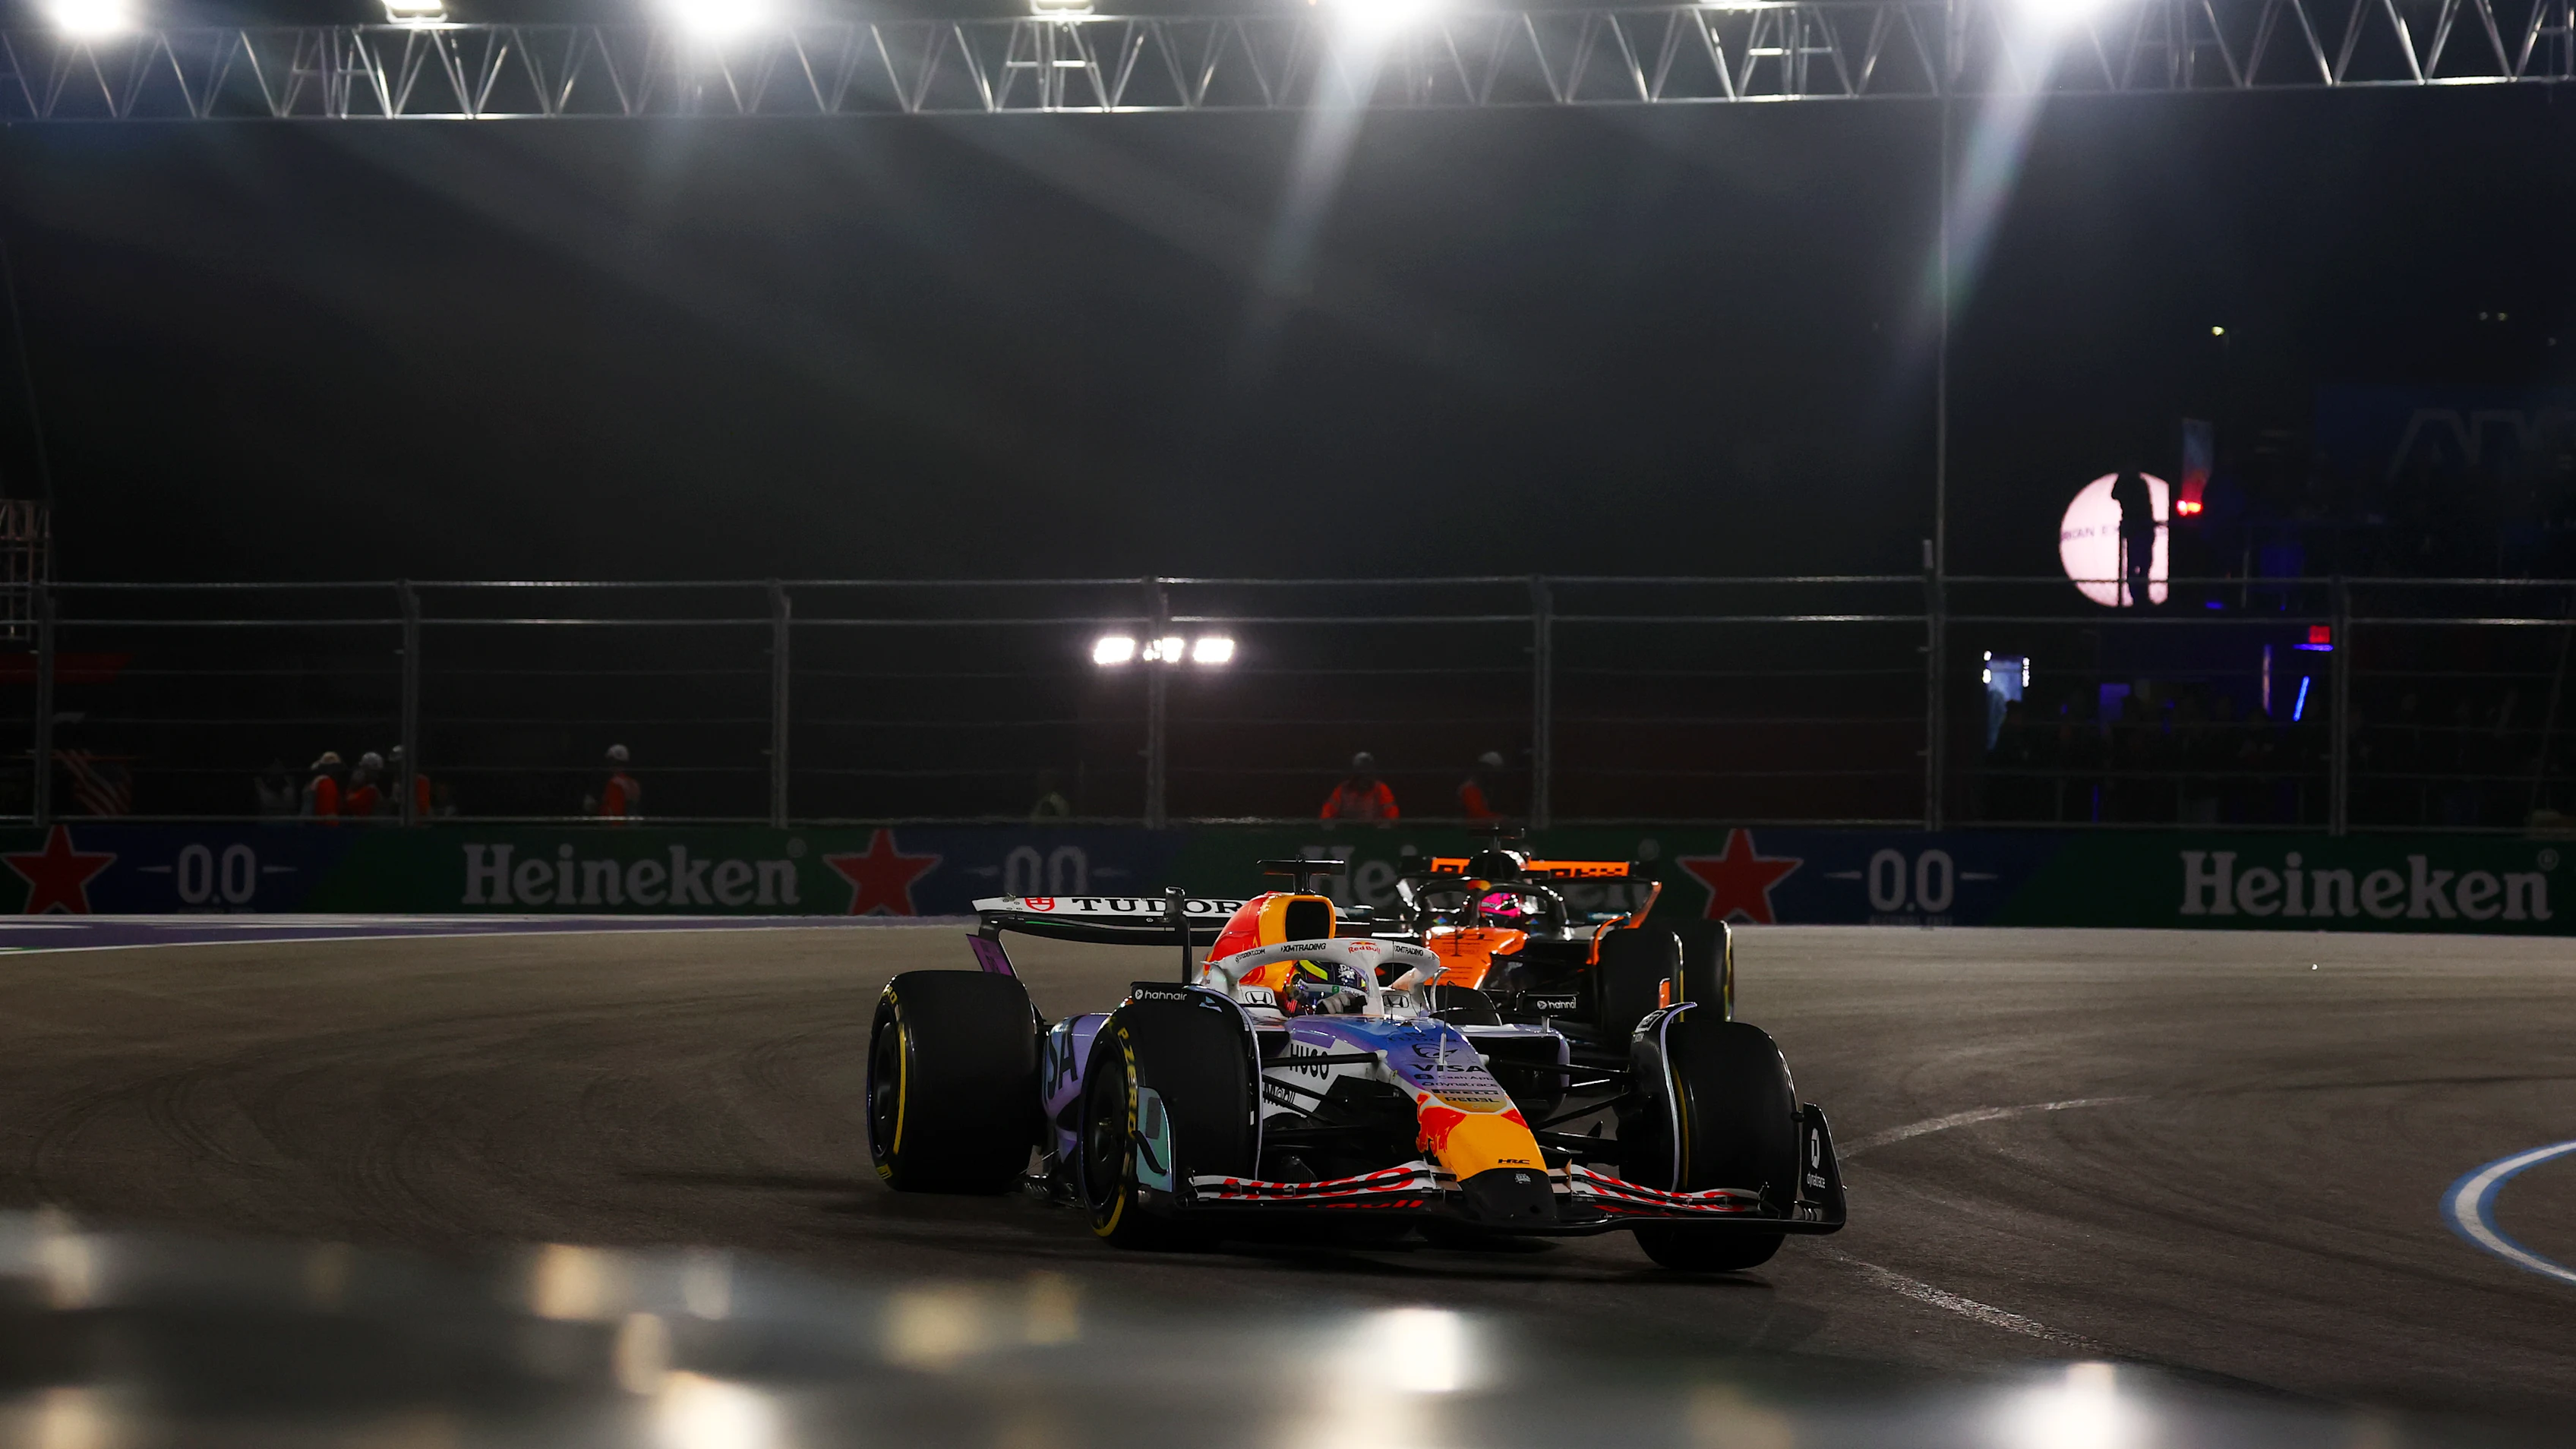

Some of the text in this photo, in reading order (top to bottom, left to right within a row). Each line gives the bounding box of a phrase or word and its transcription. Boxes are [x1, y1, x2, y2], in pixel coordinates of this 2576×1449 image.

[462, 843, 800, 907] Heineken
[2178, 849, 2555, 921] Heineken
[1072, 898, 1242, 914] TUDOR
[1144, 989, 1188, 1002] hahnair
[1411, 1064, 1487, 1073] VISA
